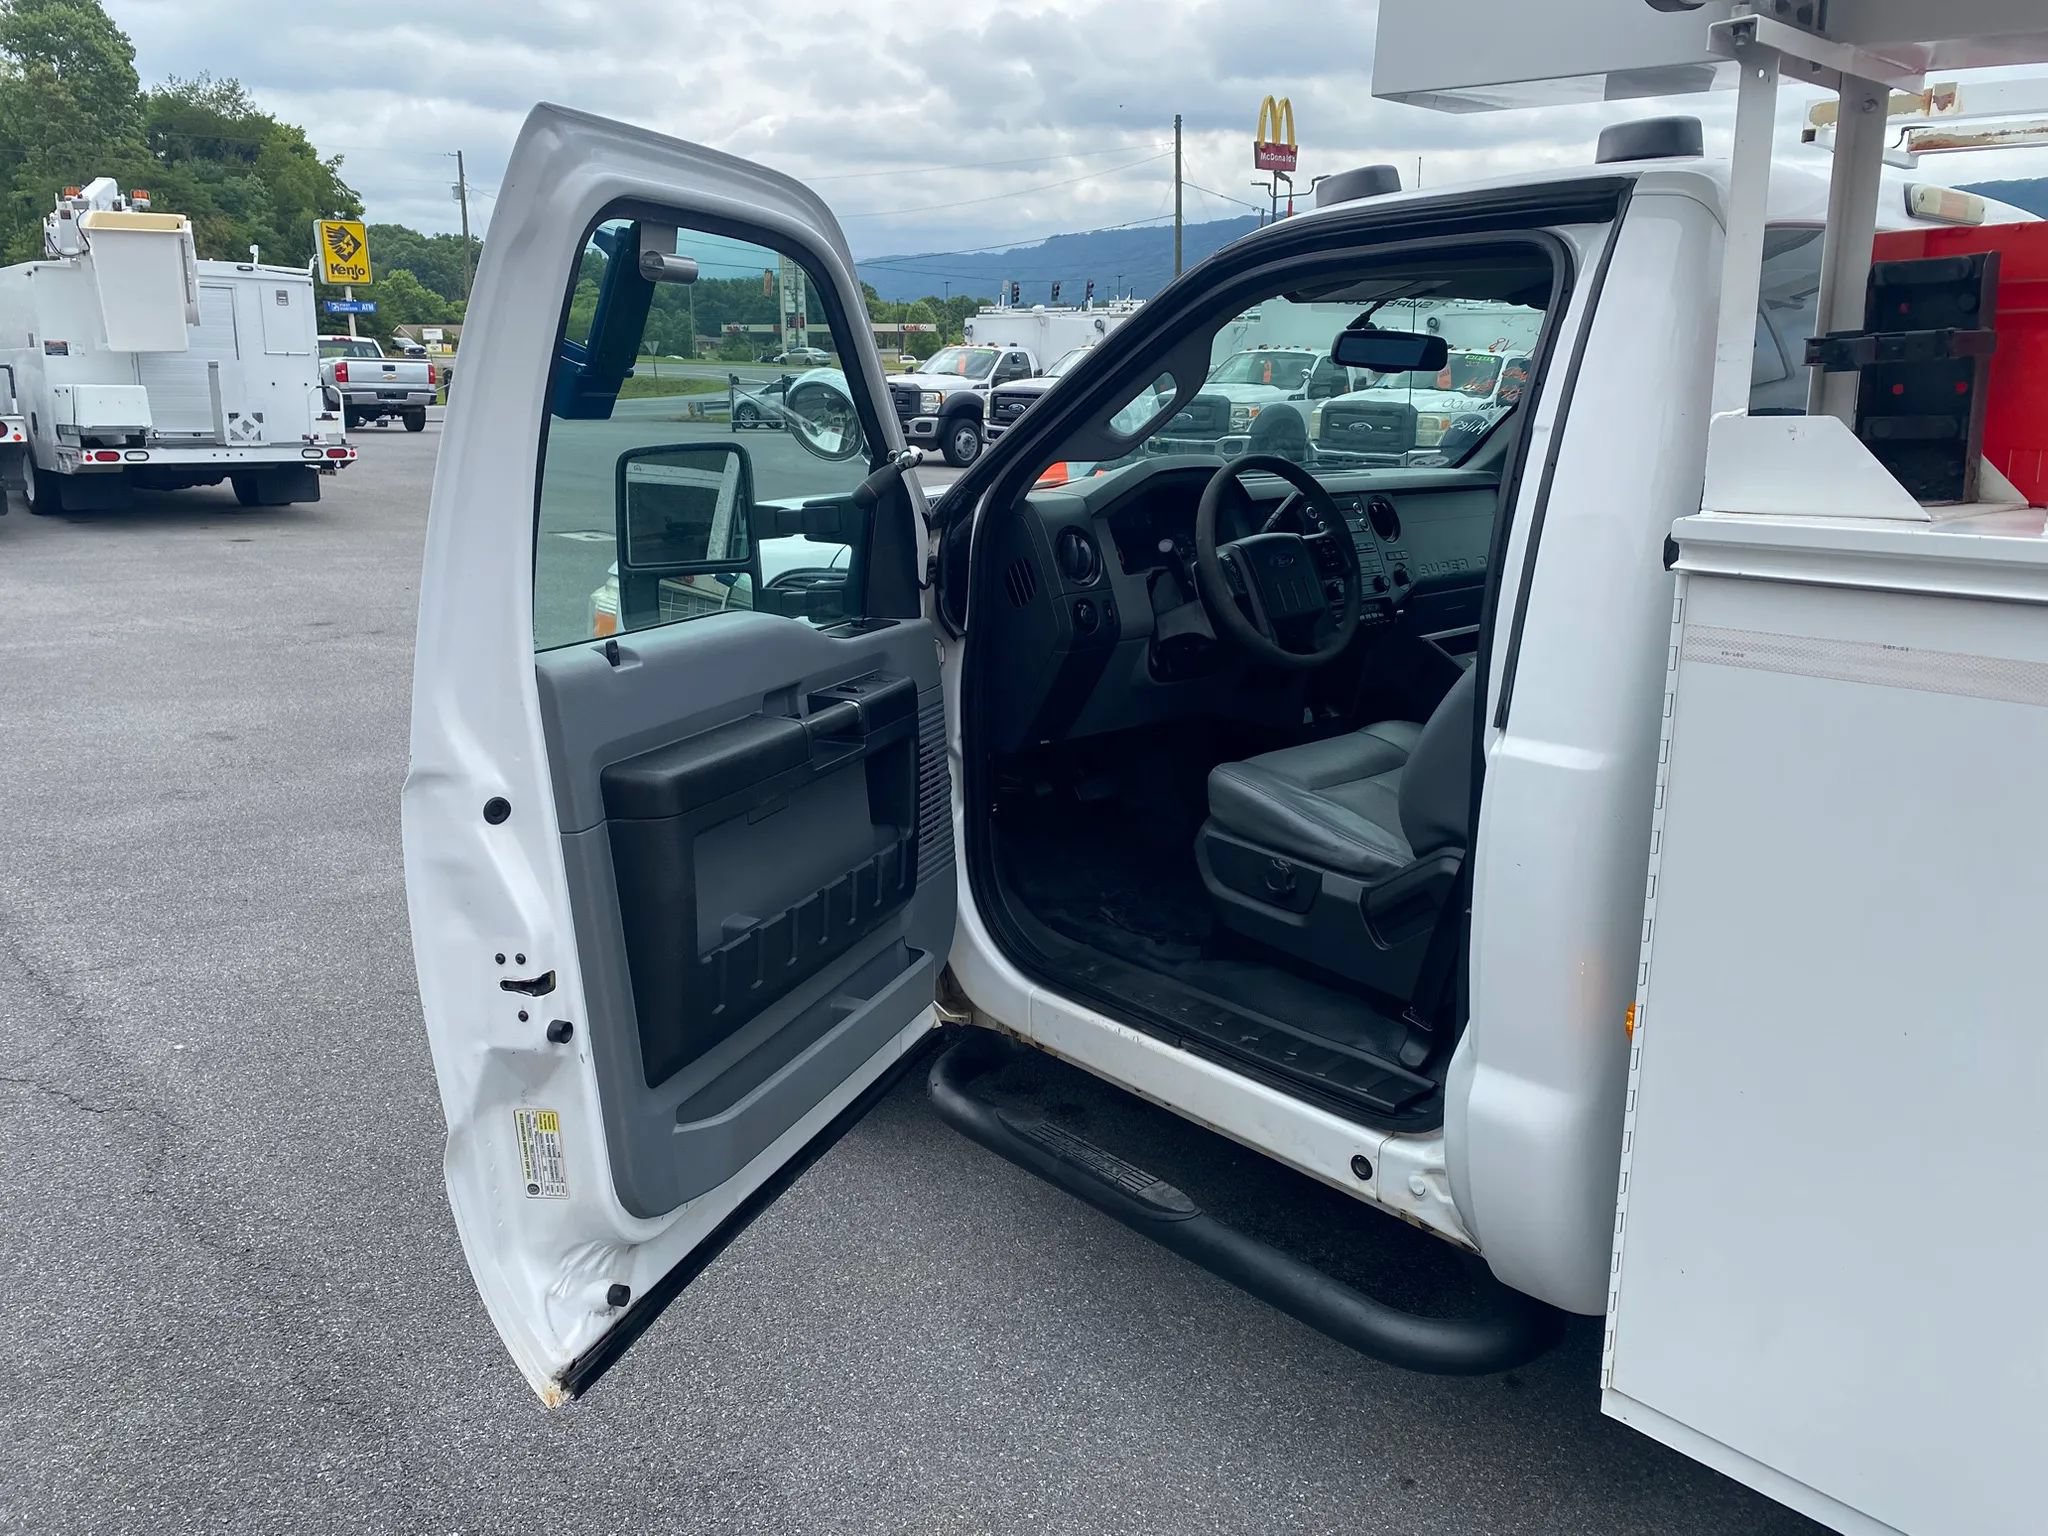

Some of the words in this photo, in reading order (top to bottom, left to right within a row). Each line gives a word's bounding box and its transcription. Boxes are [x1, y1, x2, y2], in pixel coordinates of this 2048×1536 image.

[1260, 152, 1296, 163] McDonald's
[361, 303, 374, 311] ATM
[1420, 558, 1470, 576] SUPER
